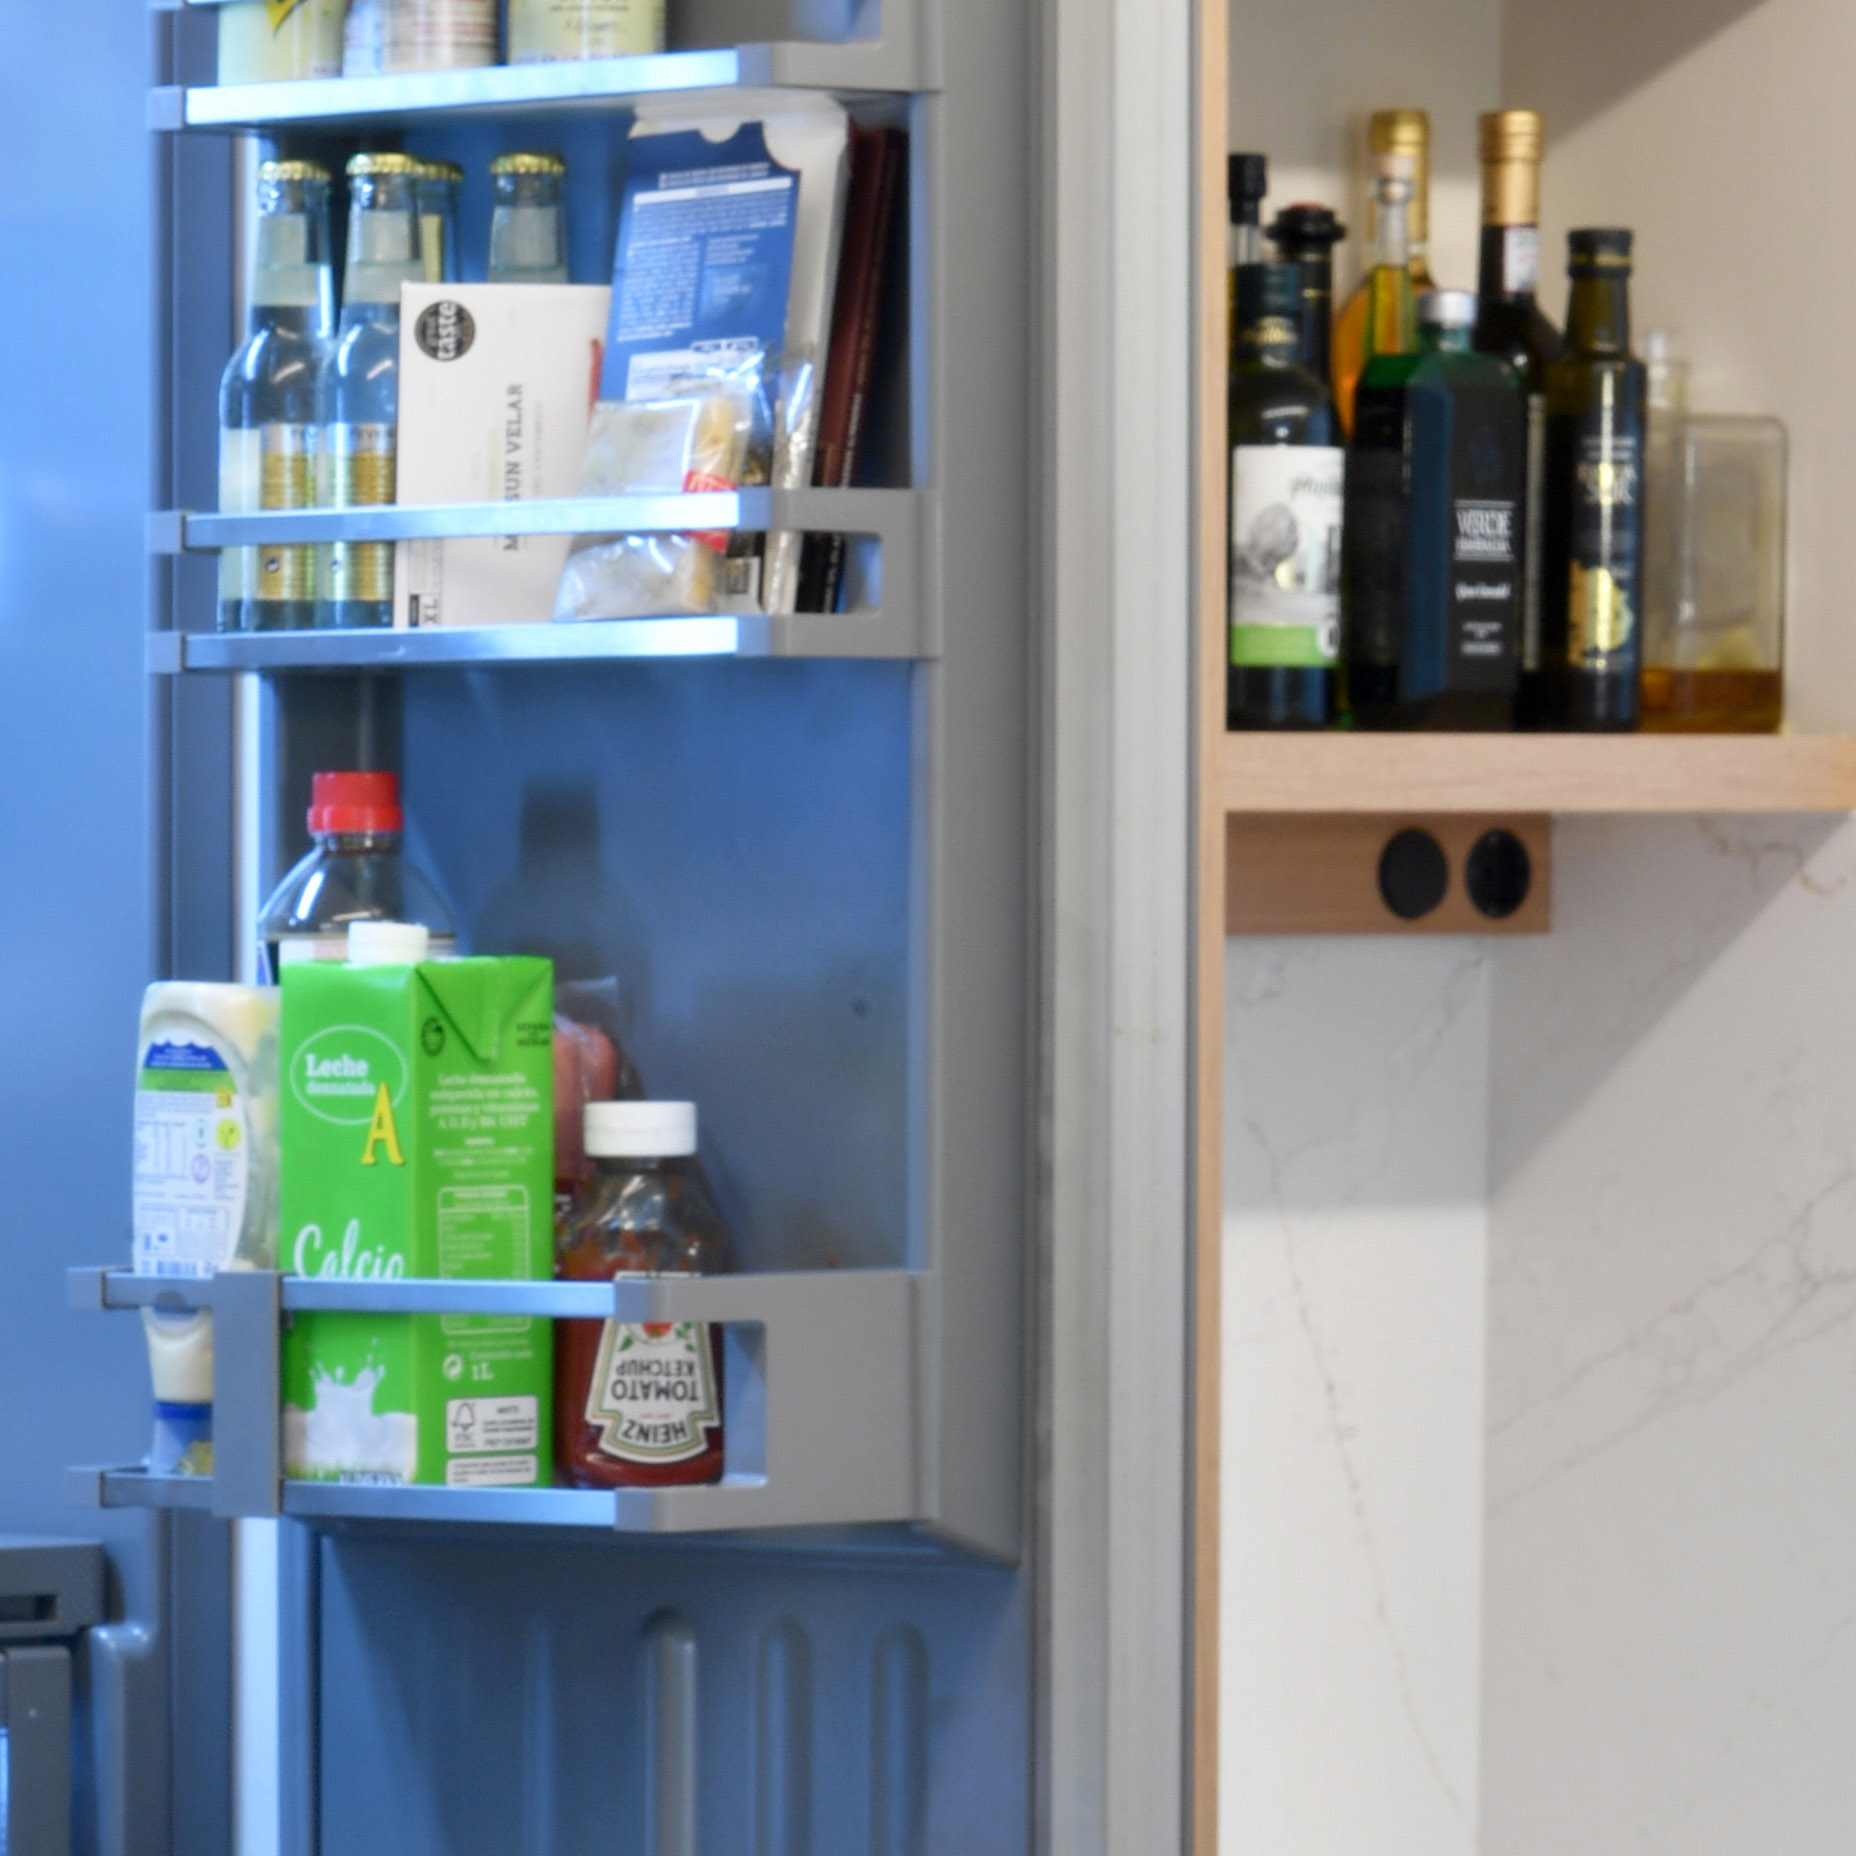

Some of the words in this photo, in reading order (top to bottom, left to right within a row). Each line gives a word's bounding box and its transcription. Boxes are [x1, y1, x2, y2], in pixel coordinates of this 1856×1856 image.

[505, 382, 523, 455] VELAR
[305, 1053, 369, 1078] Leche
[361, 1080, 406, 1166] A
[615, 1359, 696, 1378] KETCHUP
[610, 1379, 701, 1403] TOMATO
[620, 1419, 688, 1444] HEINZ
